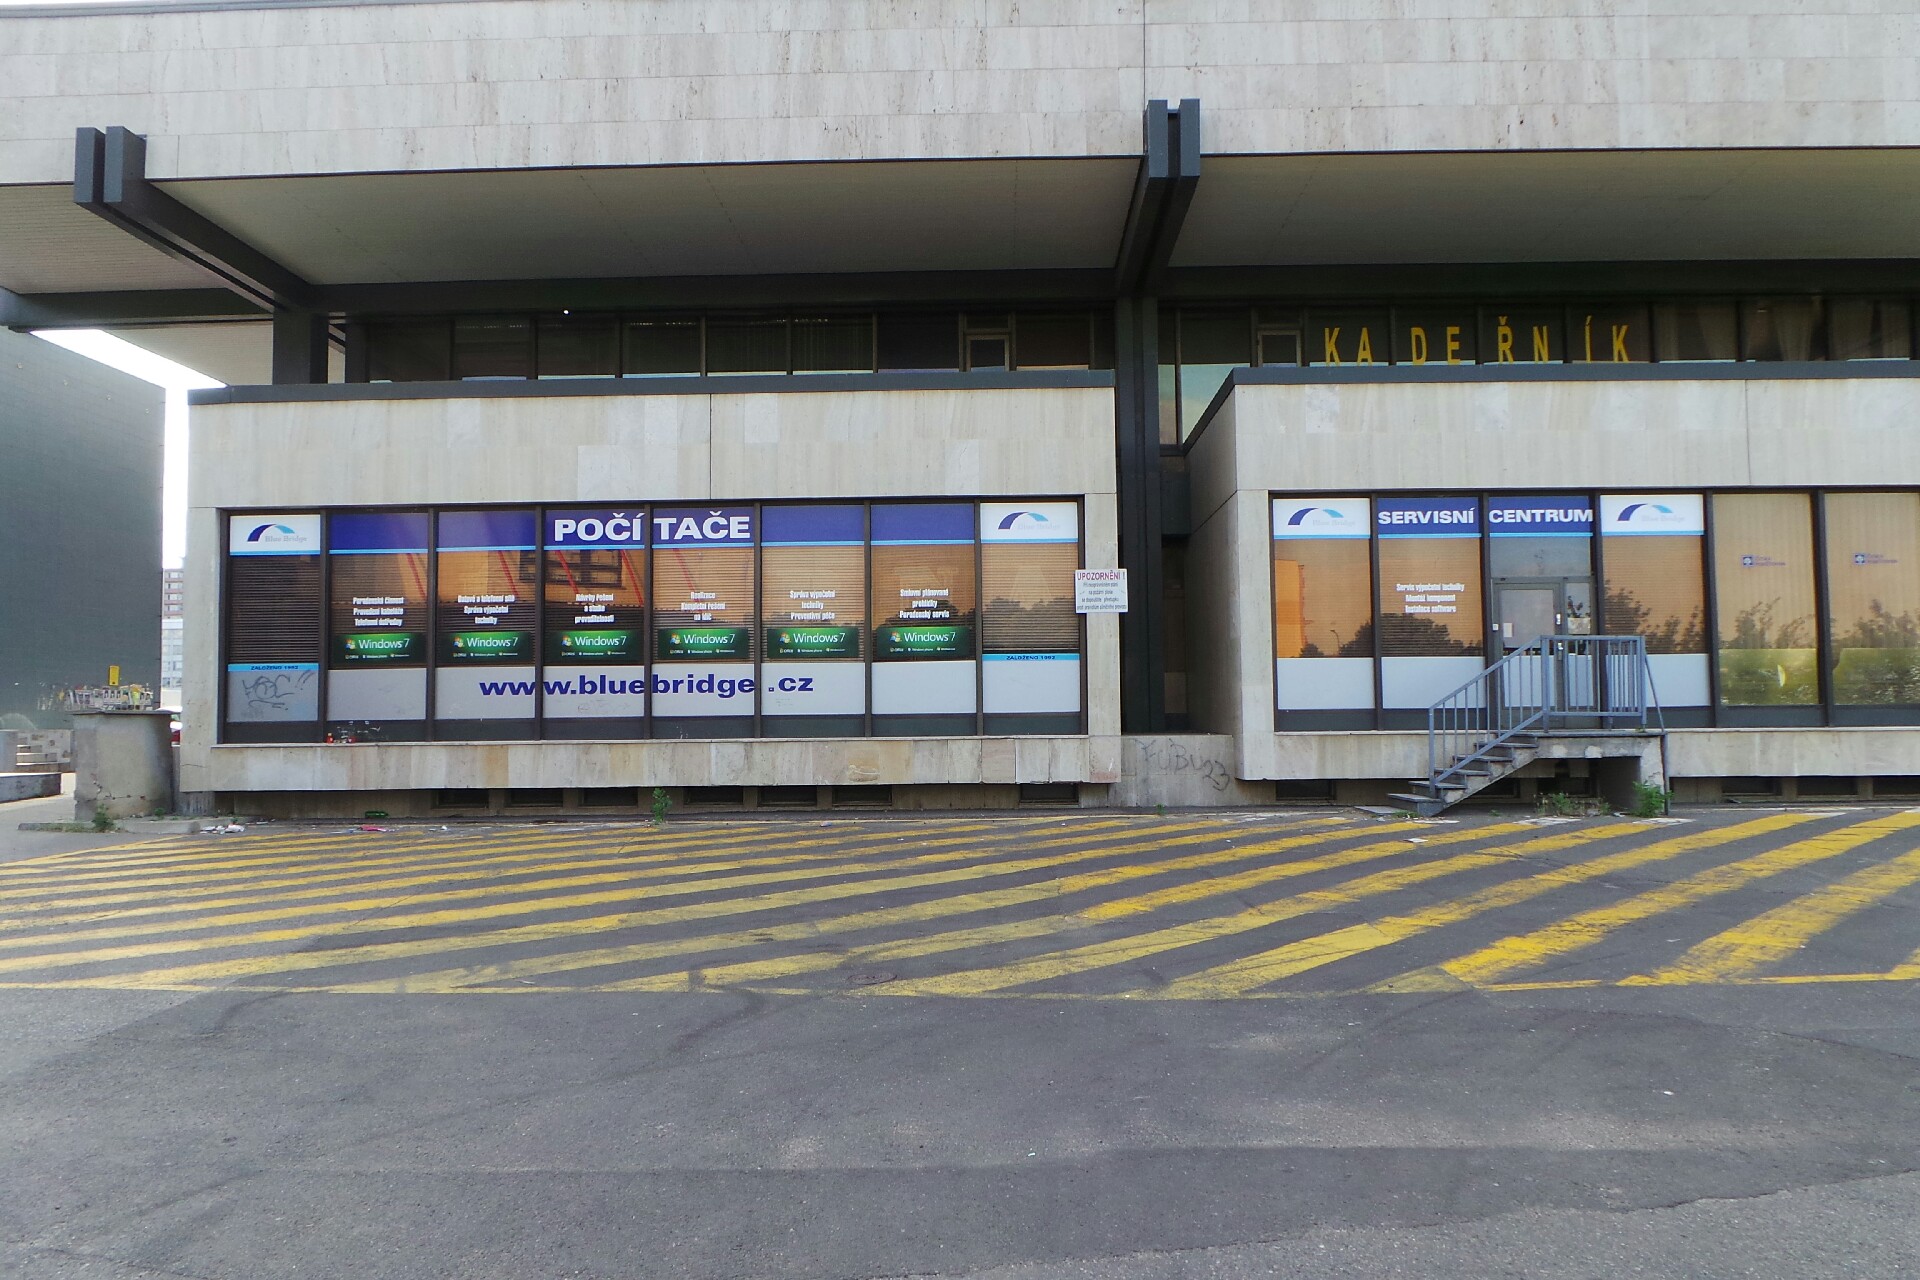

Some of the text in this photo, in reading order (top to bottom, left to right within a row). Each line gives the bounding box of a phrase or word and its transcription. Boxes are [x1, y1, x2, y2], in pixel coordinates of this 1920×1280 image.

[1378, 507, 1594, 525] SERVISNÍ CENTRUM
[265, 535, 308, 544] Blue Bridge
[466, 637, 511, 647] Windows
[574, 635, 620, 646] Windows
[683, 633, 729, 644] Windows
[792, 632, 838, 643] Windows
[903, 631, 949, 642] Windows
[358, 638, 403, 649] Windows
